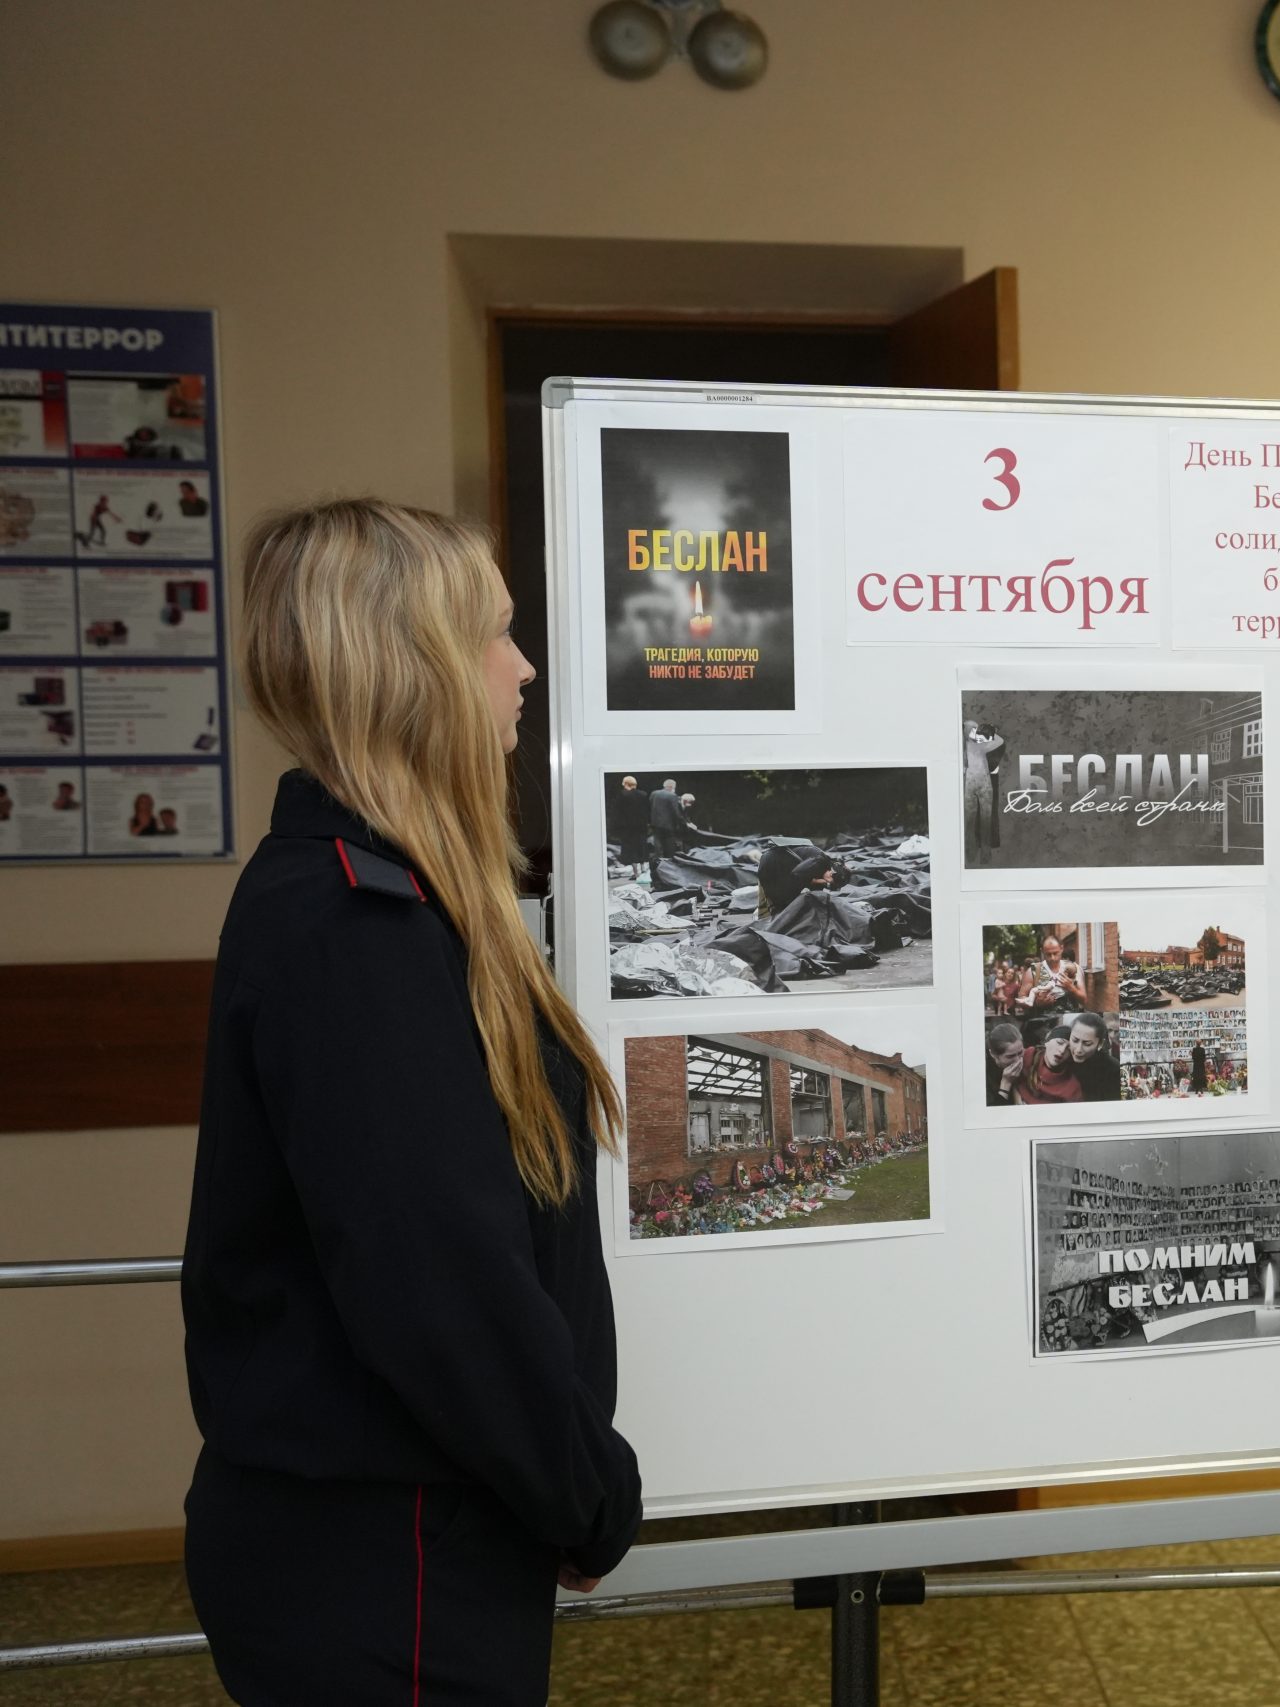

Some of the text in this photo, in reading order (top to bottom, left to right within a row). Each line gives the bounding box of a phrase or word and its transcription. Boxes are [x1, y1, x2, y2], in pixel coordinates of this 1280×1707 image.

[1184, 442, 1253, 475] День
[981, 447, 1022, 511] 3
[628, 529, 768, 572] БЕСЛАН
[856, 558, 1149, 631] сентября
[644, 648, 759, 663] ТРАГЕДИЯ, КОТОРУЮ
[650, 665, 755, 680] НИКТО НЕ ЗАБУДЕТ
[1019, 754, 1209, 802] БЕСЛАН
[1003, 778, 1226, 826] Боль всей страны
[1099, 1242, 1257, 1274] ПОМНИМ
[1108, 1277, 1250, 1308] БЕСЛАН
